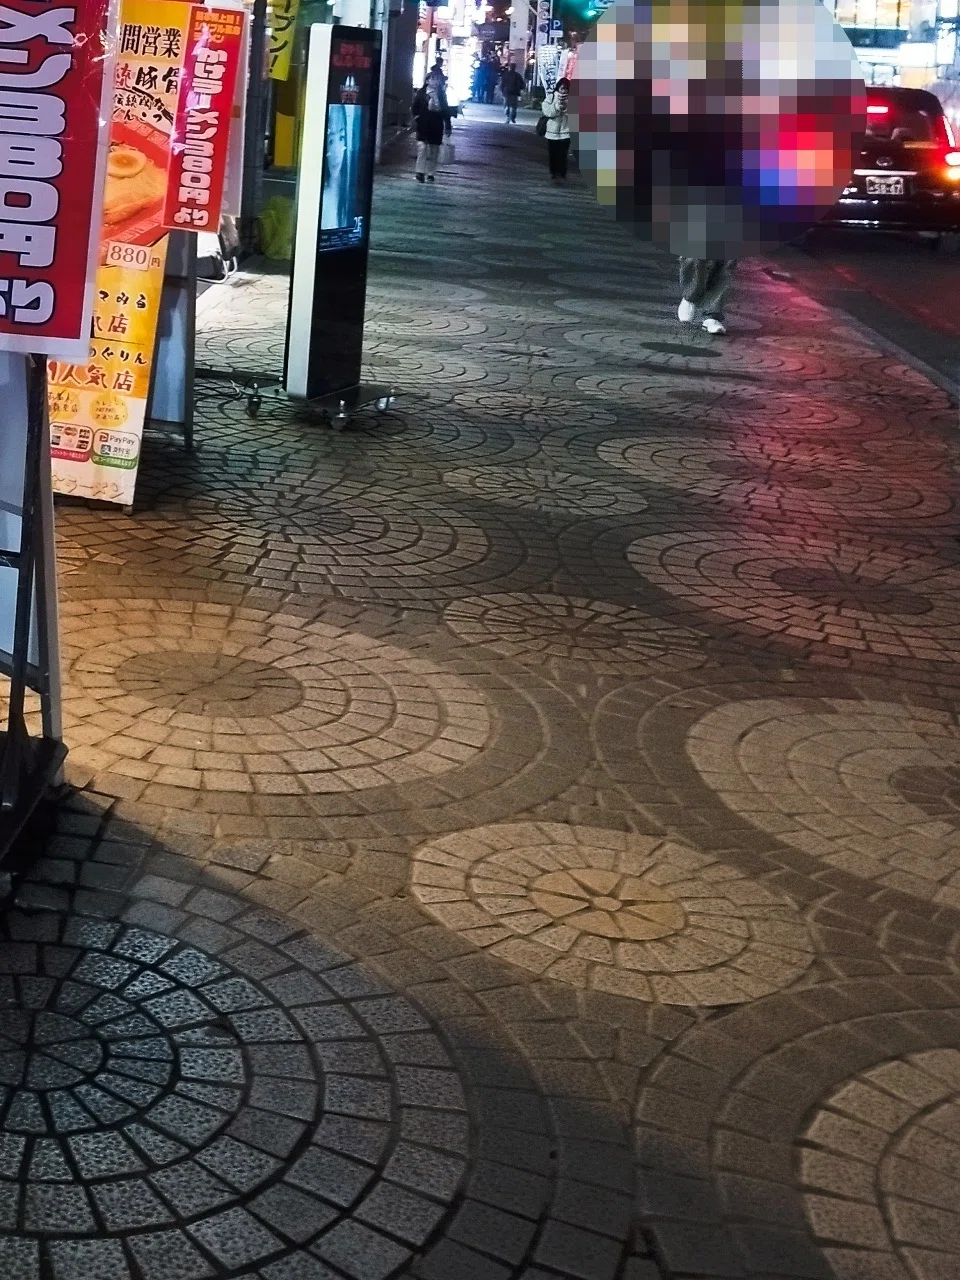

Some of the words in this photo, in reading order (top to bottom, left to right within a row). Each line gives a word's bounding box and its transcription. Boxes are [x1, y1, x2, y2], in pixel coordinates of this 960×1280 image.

[553, 20, 561, 29] P
[119, 23, 182, 59] 間営業
[110, 434, 136, 446] PayPay
